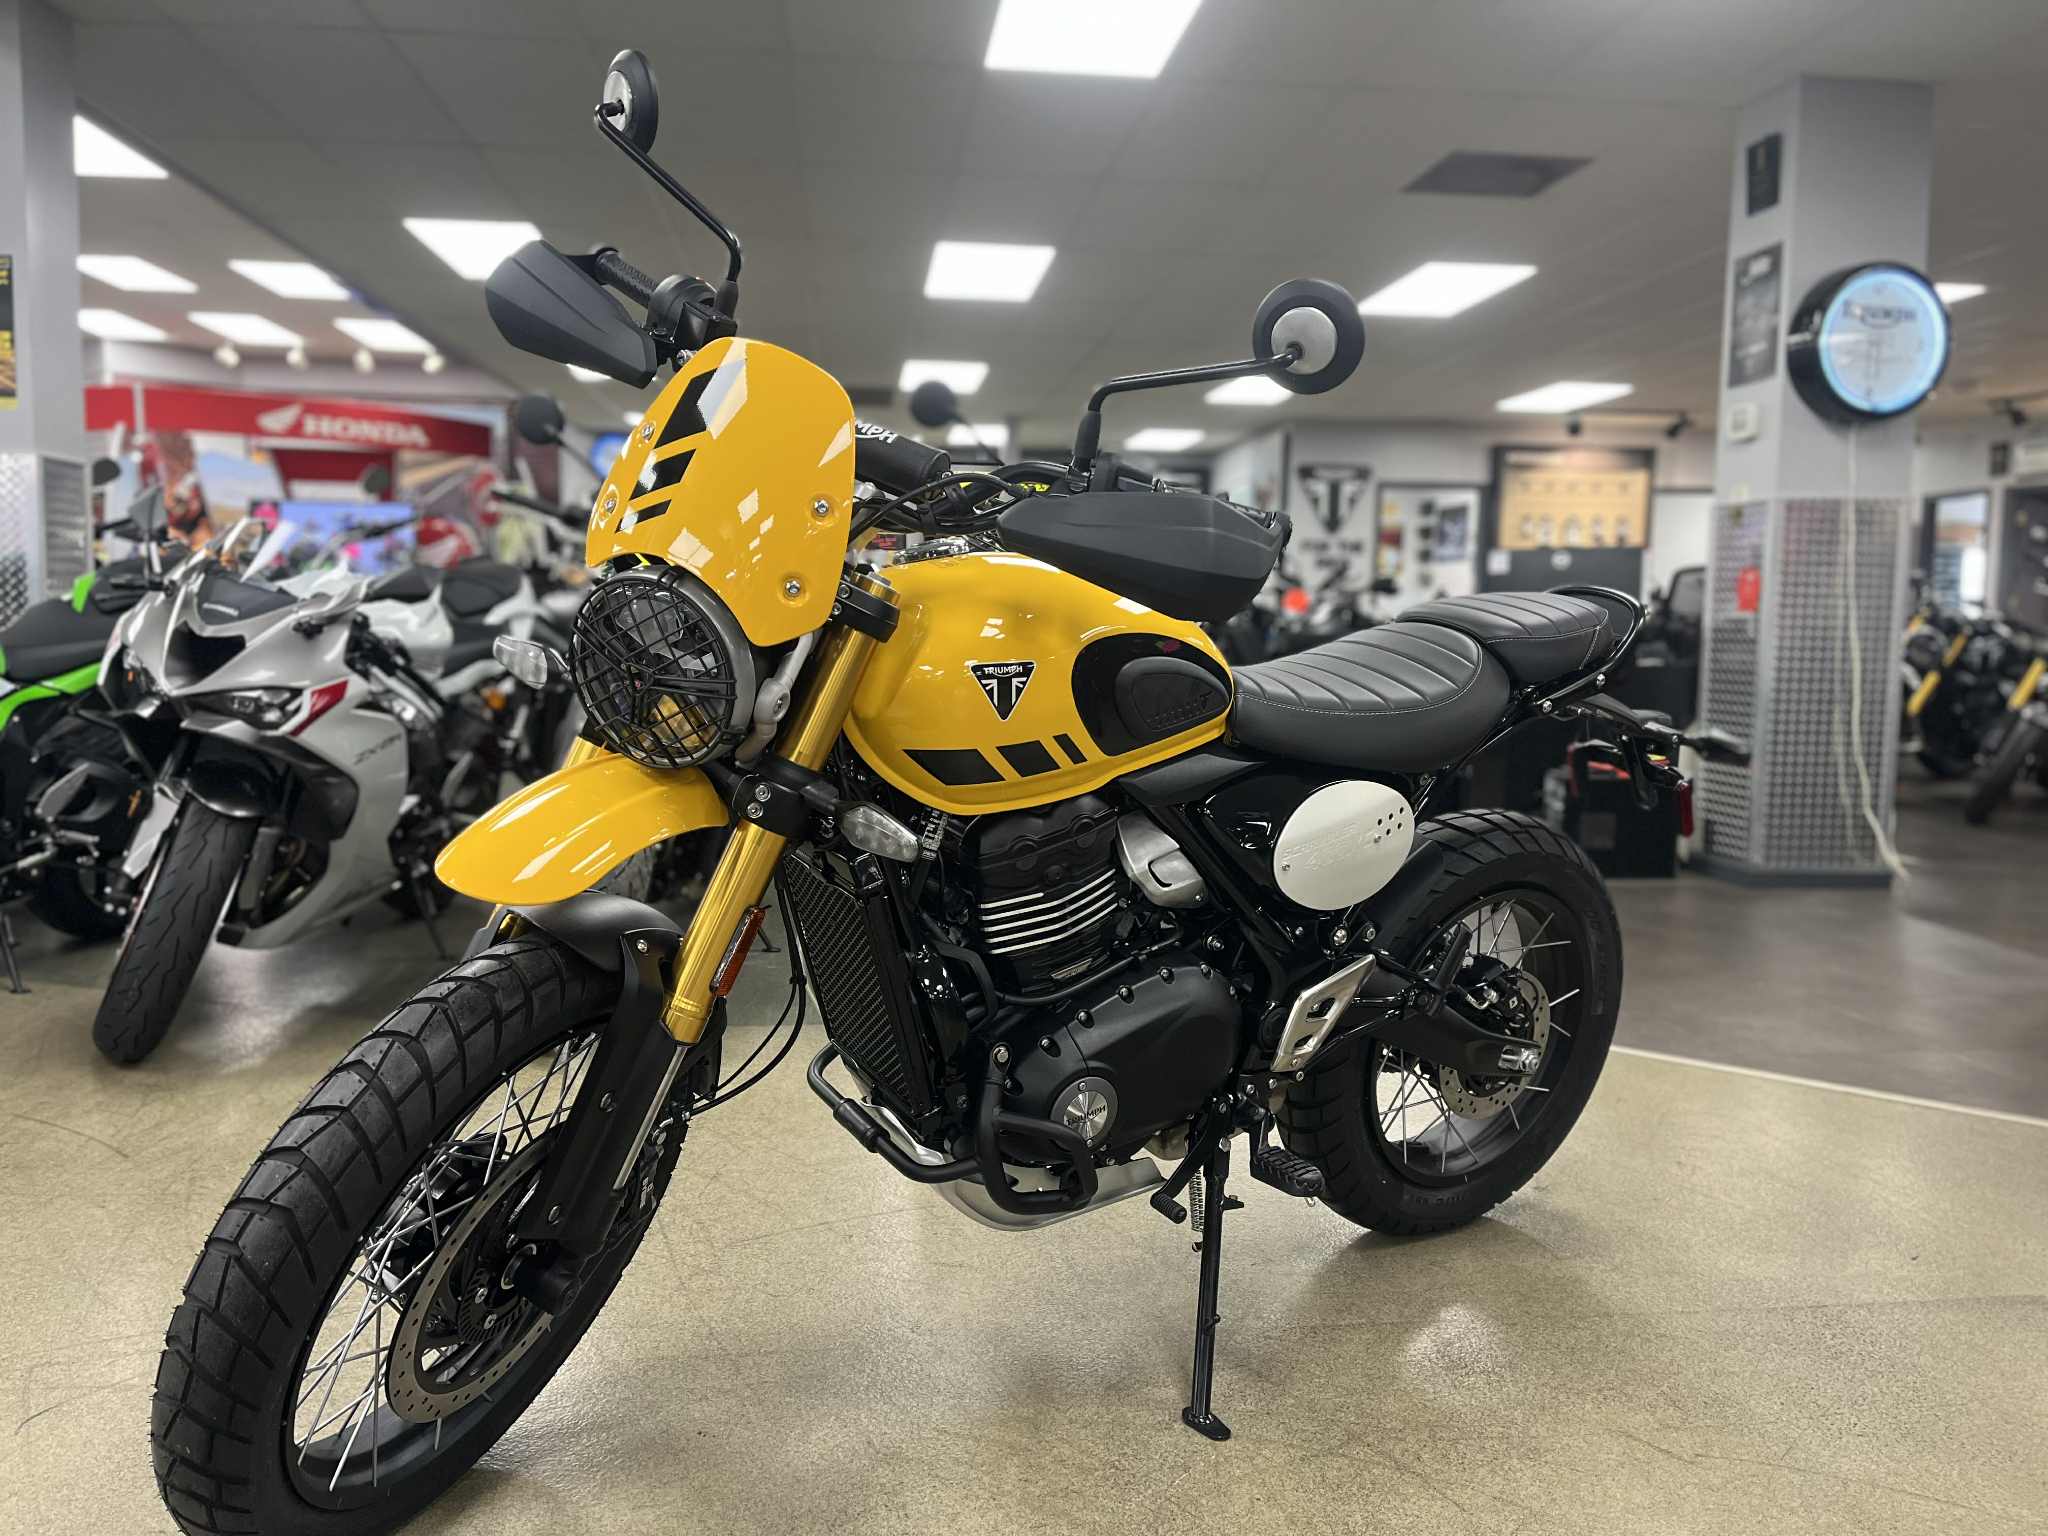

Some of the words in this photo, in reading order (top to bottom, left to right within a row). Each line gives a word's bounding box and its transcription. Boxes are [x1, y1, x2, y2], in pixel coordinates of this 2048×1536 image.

[303, 413, 430, 448] HONDA
[983, 665, 1023, 677] TRIUMPH
[1065, 1105, 1106, 1127] TRIUMPH
